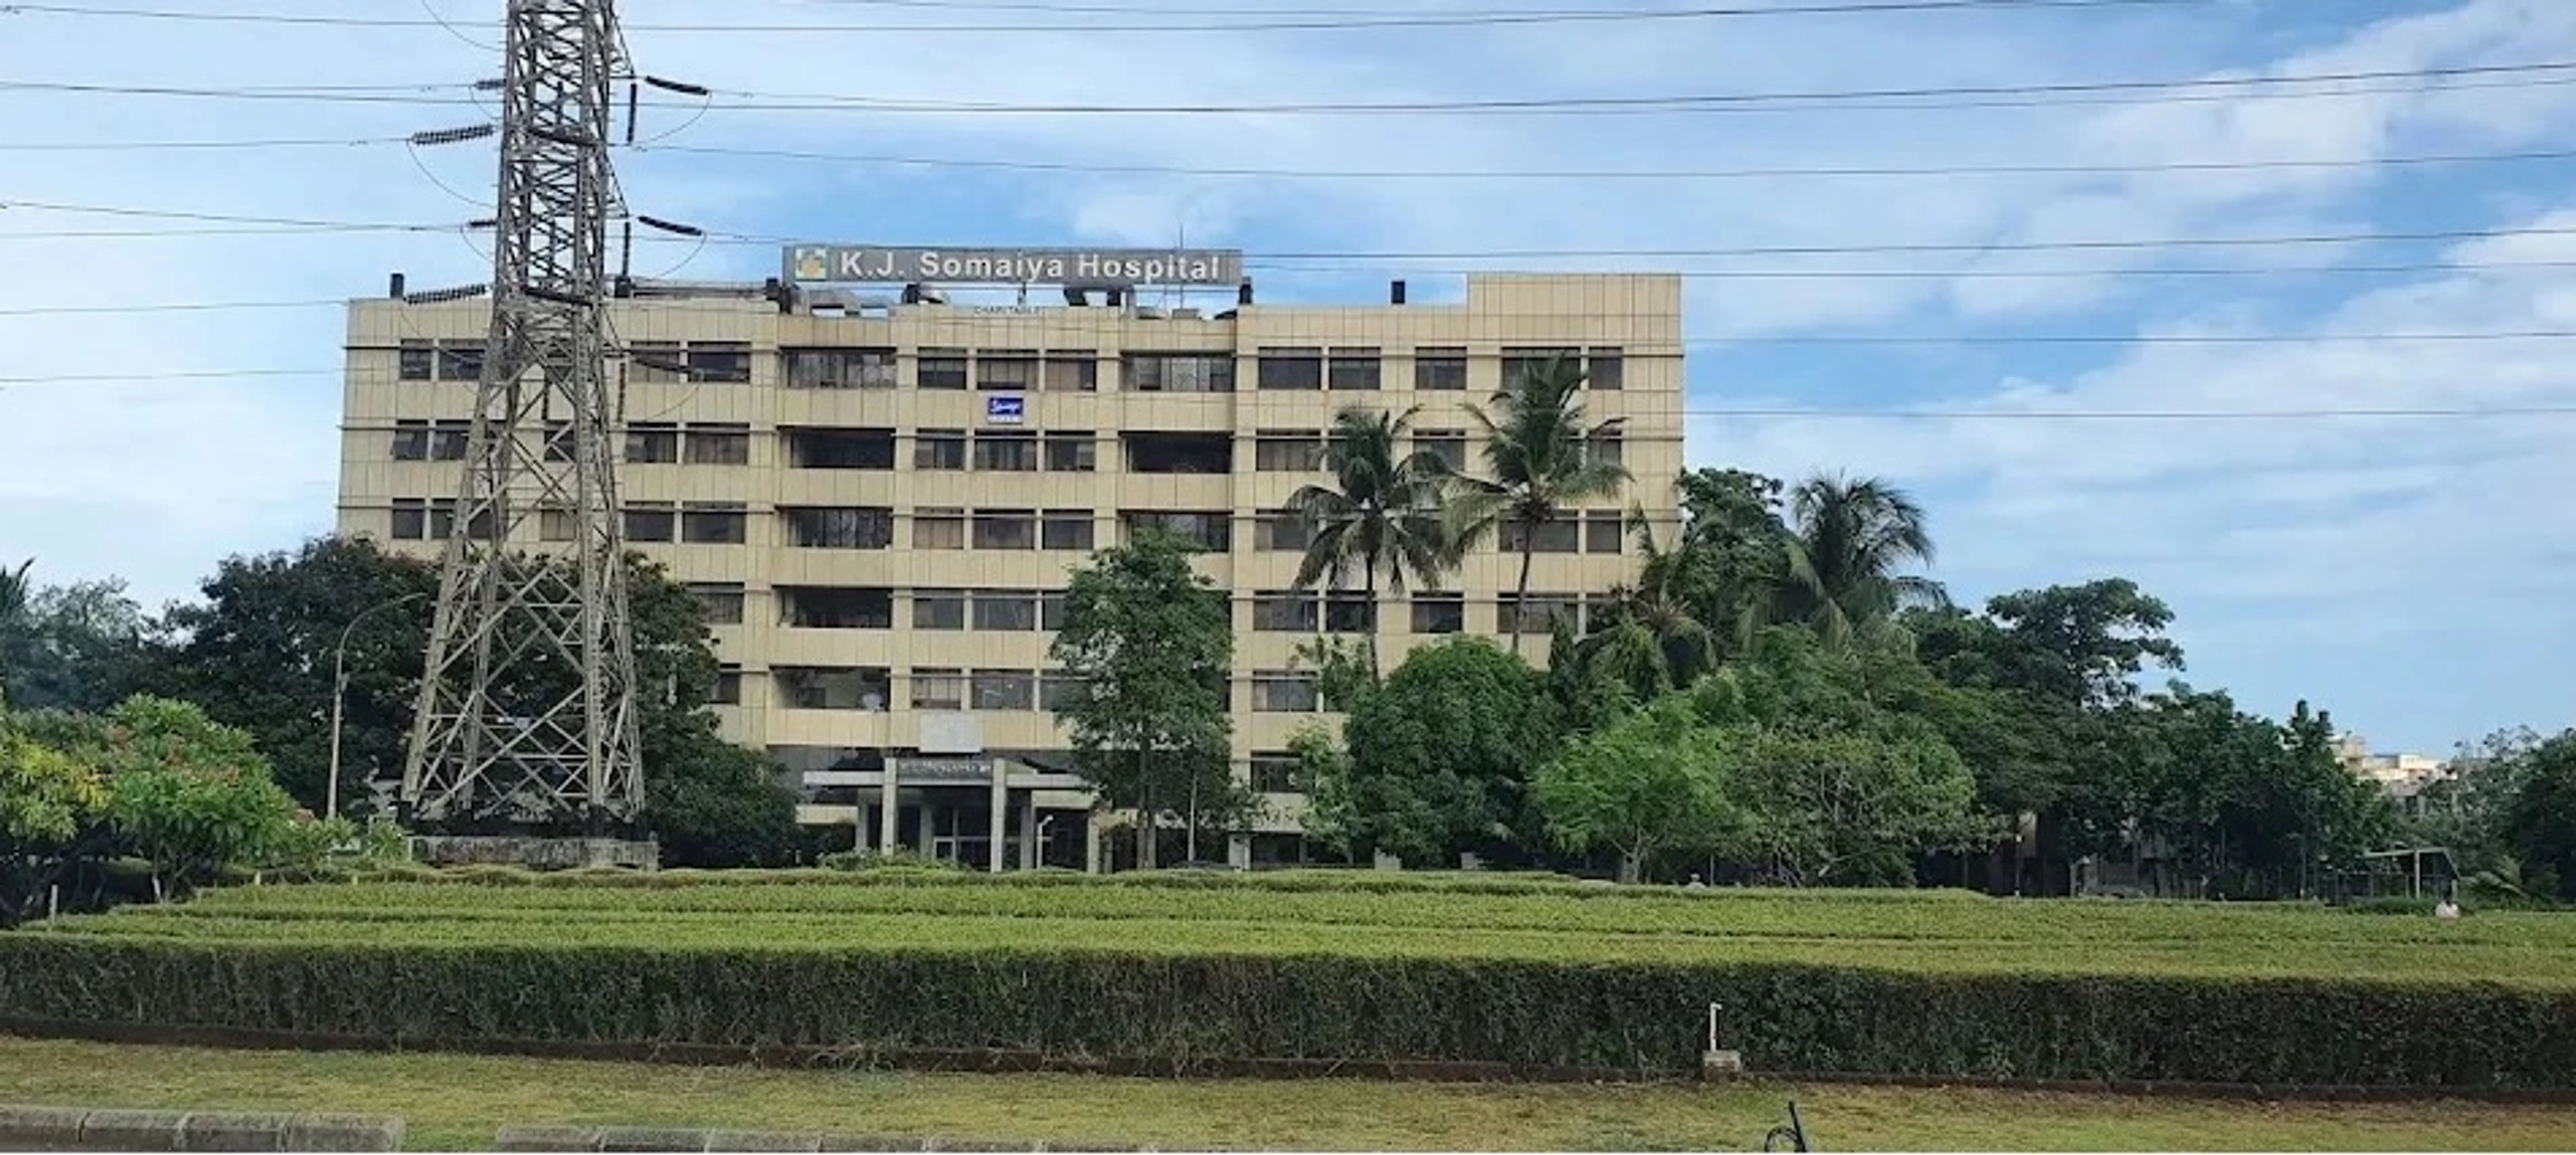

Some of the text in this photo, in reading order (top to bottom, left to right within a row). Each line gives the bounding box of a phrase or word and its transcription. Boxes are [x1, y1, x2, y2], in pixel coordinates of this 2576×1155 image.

[841, 252, 1219, 284] K.J. Somaiya Hospital
